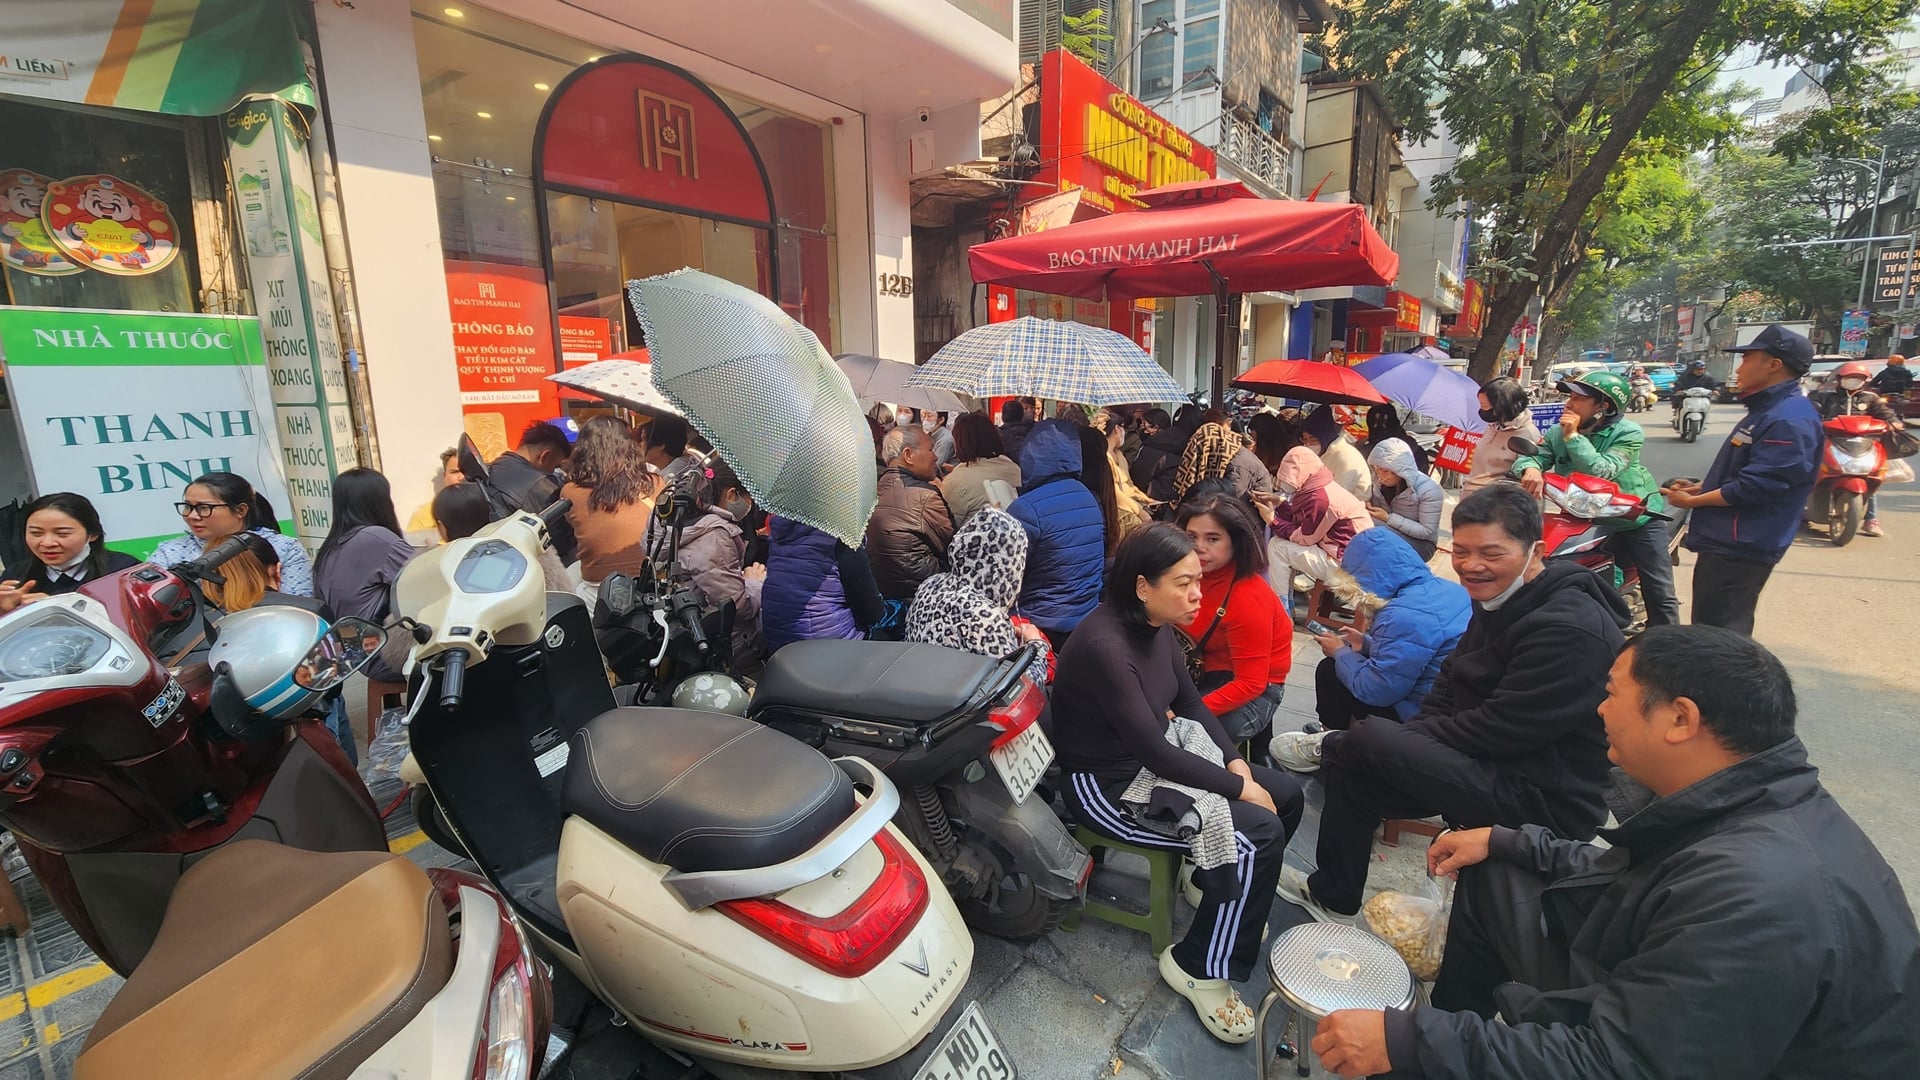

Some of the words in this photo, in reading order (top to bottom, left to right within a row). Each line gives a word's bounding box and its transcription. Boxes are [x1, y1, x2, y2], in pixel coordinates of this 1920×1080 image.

[227, 110, 268, 131] Eugica
[1147, 115, 1164, 139] TY
[1084, 103, 1148, 183] MINH
[1048, 250, 1085, 269] BAO
[1088, 245, 1123, 264] TIN
[1127, 238, 1193, 261] MANH
[1198, 234, 1239, 252] HAI
[1882, 252, 1900, 260] KIM
[266, 280, 285, 303] XỊT
[879, 272, 913, 295] 12B
[1882, 289, 1901, 297] CAO
[270, 306, 293, 328] MŨI
[32, 325, 114, 348] NHÀ
[120, 327, 233, 349] THUỐC
[266, 336, 307, 357] THÔNG
[489, 356, 508, 364] KIM
[271, 368, 312, 386] XOANG
[1611, 385, 1628, 404] Grab
[46, 409, 257, 447] THANH
[286, 412, 313, 435] NHÀ
[284, 442, 326, 467] THUỐC
[289, 478, 331, 498] THANH
[301, 505, 330, 528] BÌNH
[911, 959, 958, 1017] VINFAST
[729, 1037, 787, 1051] KLARA
